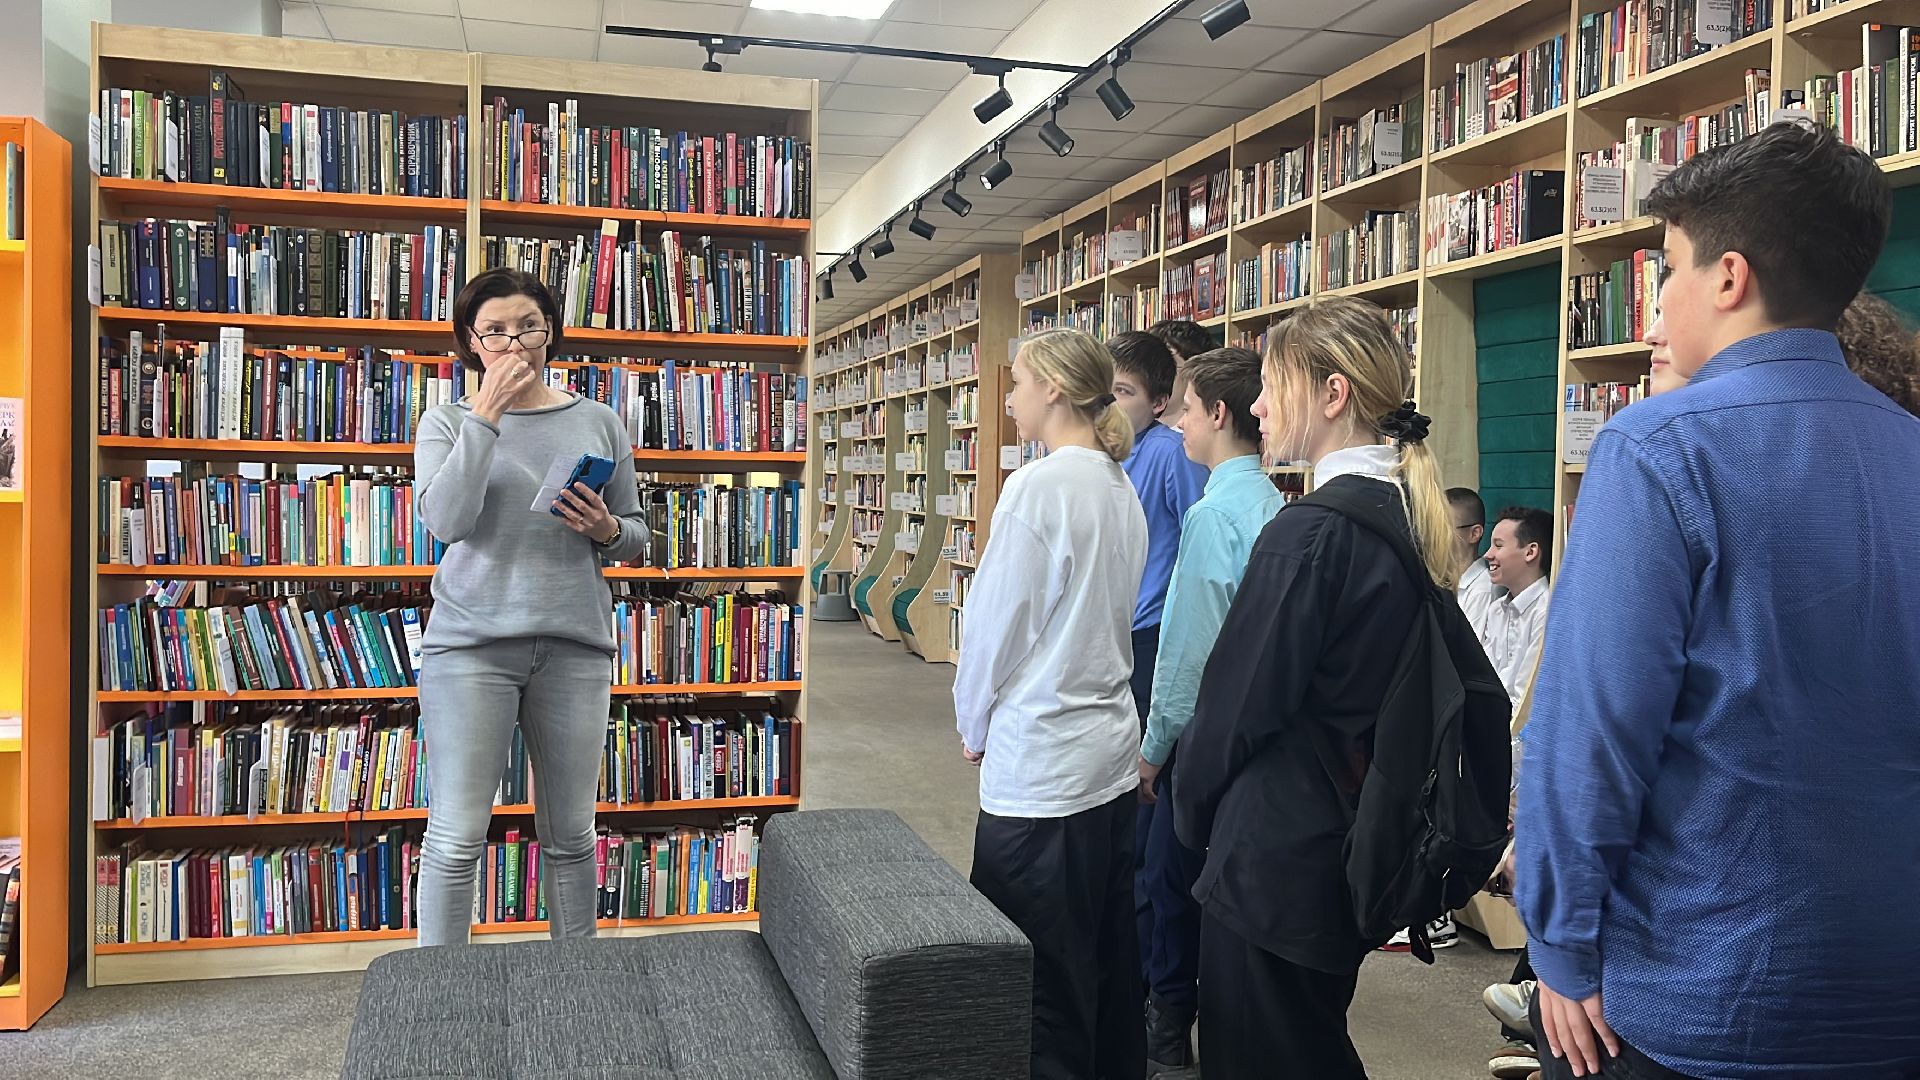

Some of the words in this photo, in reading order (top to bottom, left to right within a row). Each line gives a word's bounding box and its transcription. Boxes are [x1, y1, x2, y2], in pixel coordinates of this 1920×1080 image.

[407, 123, 416, 176] СПРАВОЧНИК
[786, 402, 794, 430] ПОЗНЕР
[272, 726, 281, 748] Dads
[618, 726, 624, 736] 2
[271, 750, 279, 781] Nordic
[508, 846, 517, 871] ENGLISH
[508, 871, 517, 902] GRAMMAR
